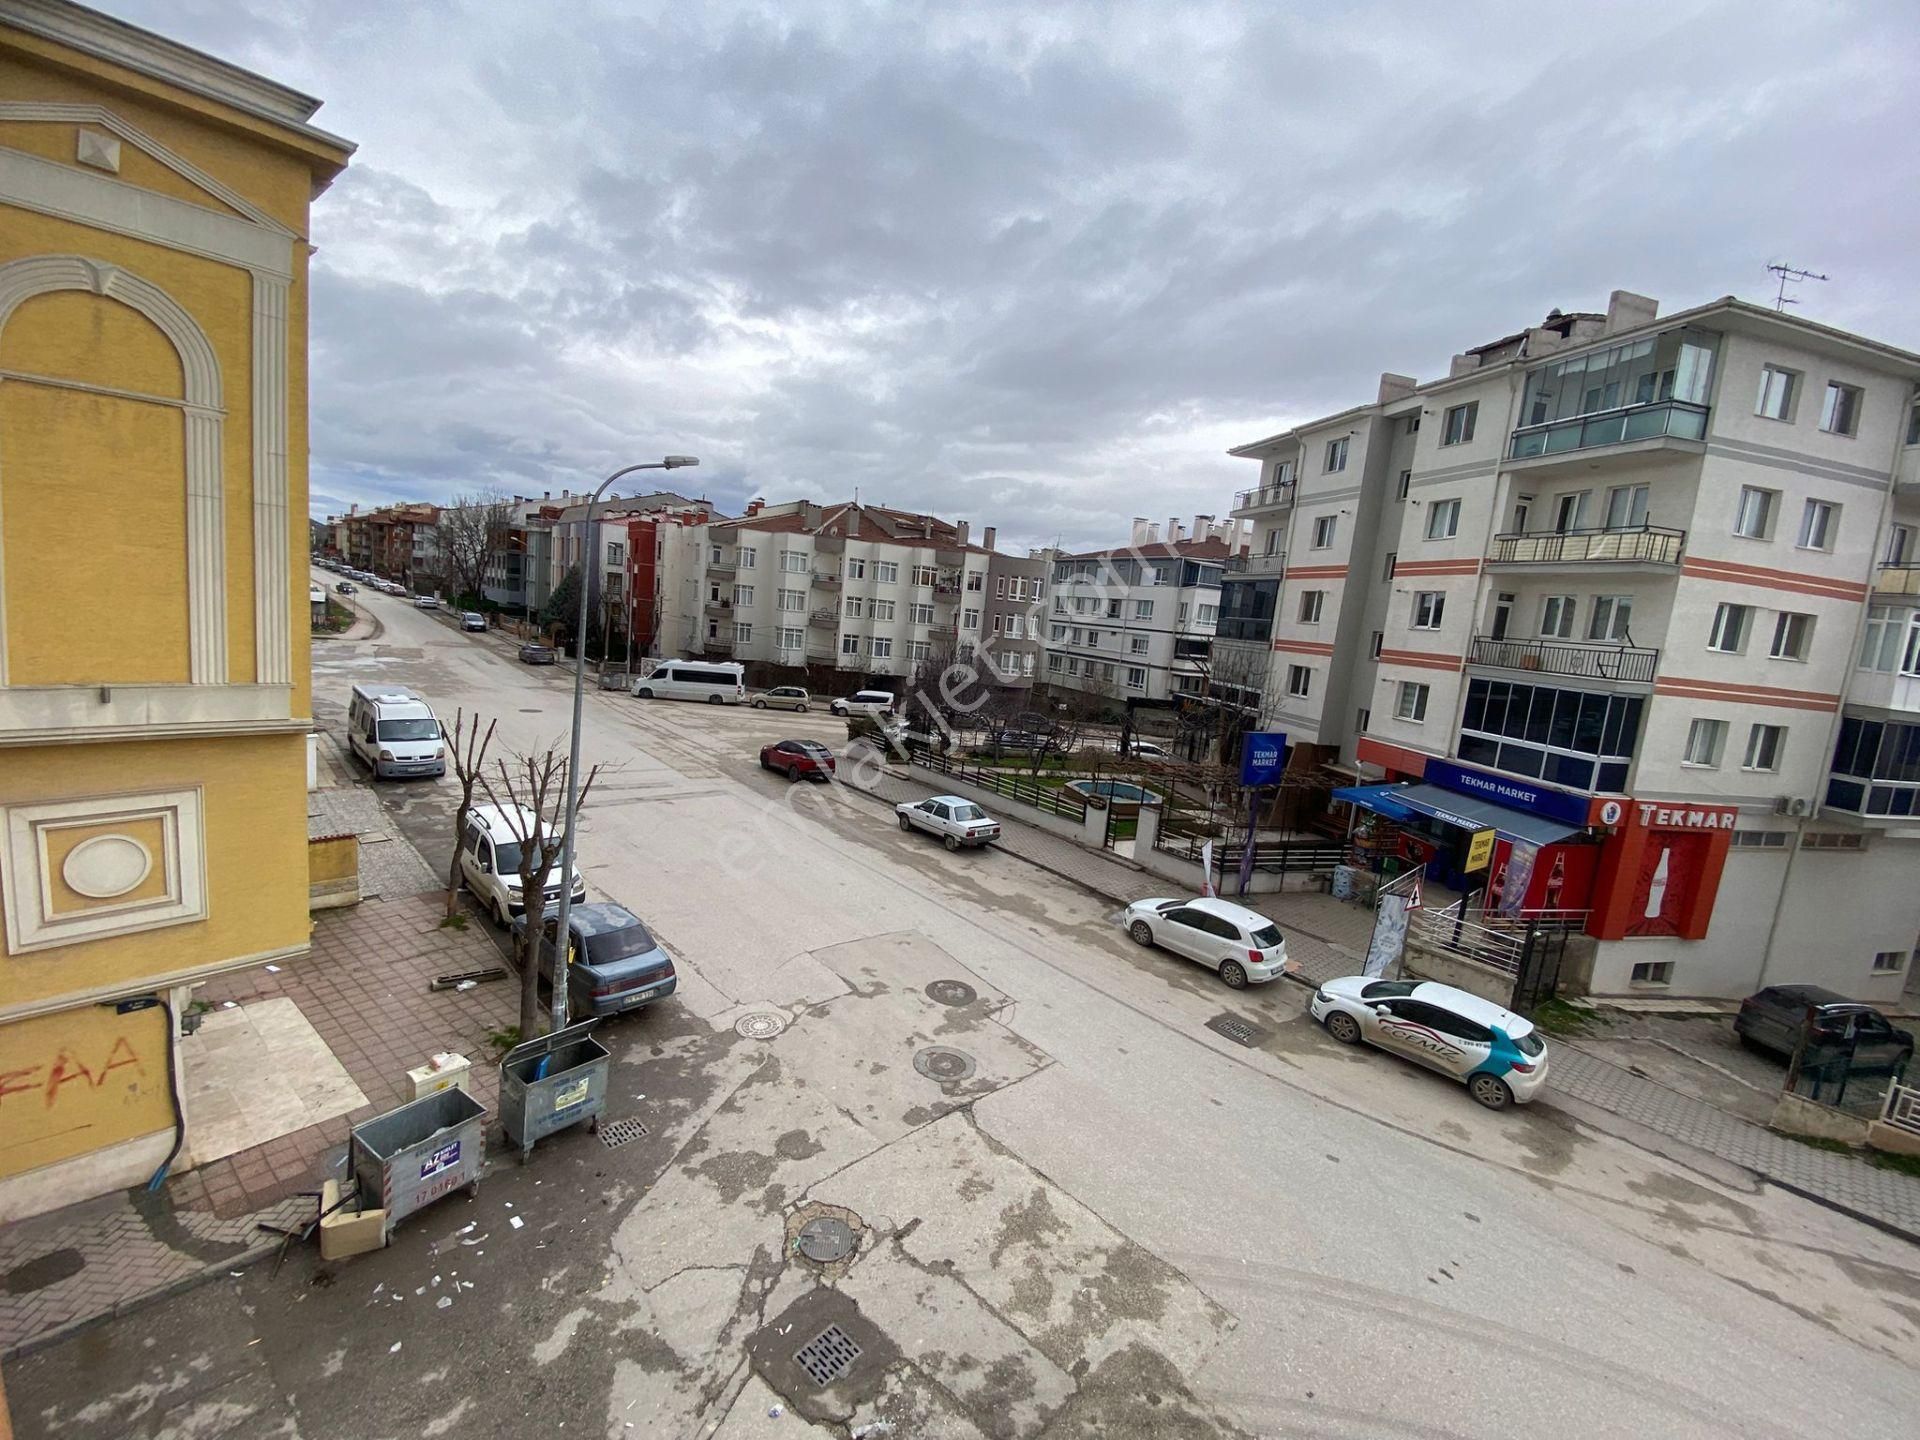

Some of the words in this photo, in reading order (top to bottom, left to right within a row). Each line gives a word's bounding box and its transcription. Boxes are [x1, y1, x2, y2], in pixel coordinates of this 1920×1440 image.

[1254, 750, 1278, 759] TEKMAR
[1252, 758, 1277, 767] MARKET
[1460, 774, 1496, 792] TEKMAR
[1497, 785, 1537, 803] MARKET
[1434, 810, 1458, 823] TEKMAR
[1639, 804, 1735, 829] TEKMAR
